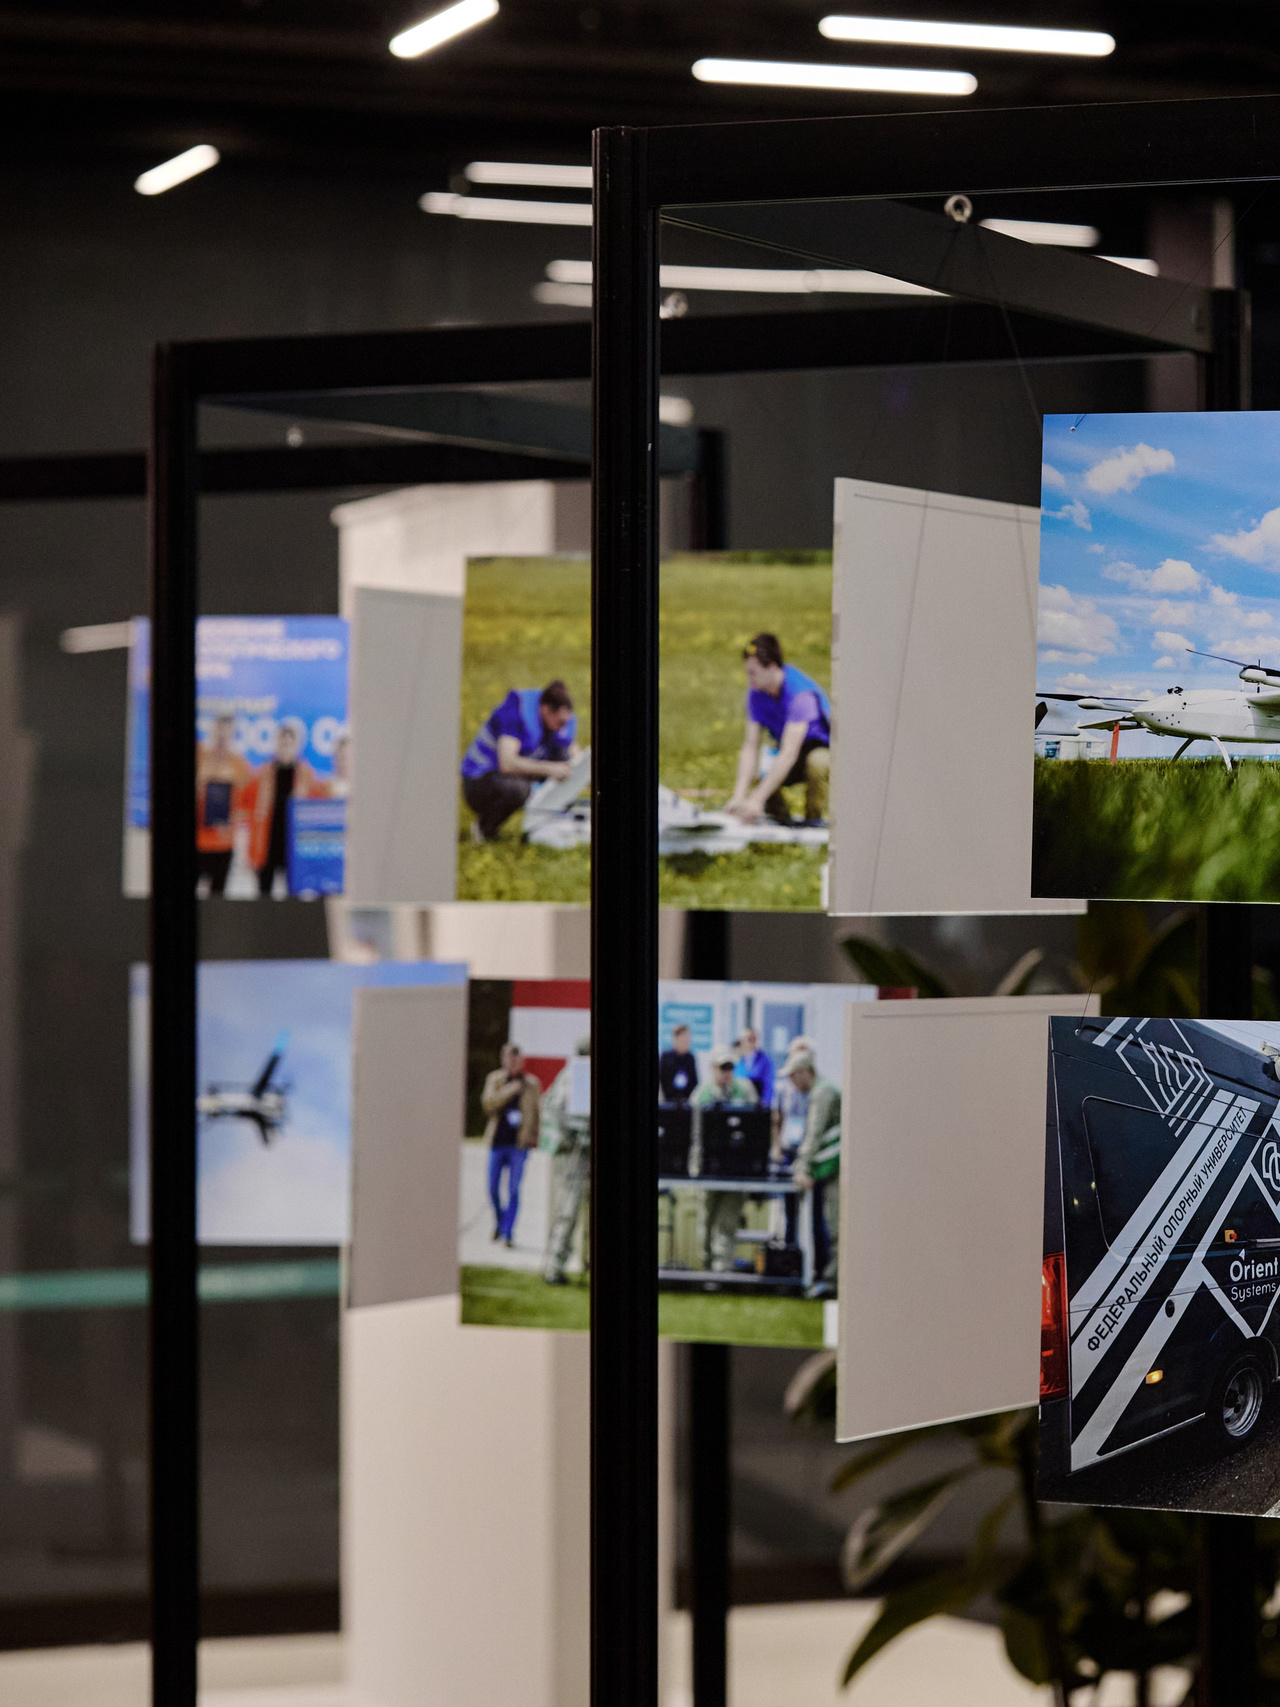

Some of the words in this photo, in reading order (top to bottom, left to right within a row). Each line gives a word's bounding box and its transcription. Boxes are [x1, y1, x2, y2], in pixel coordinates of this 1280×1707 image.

[1087, 1234, 1167, 1351] ФЕДЕРАЛЬНЫЙ
[1163, 1173, 1206, 1238] ОПОРНЫЙ
[1201, 1106, 1247, 1179] УНИВЕРСИТЕТ
[1230, 1256, 1279, 1282] Orient
[1231, 1283, 1277, 1302] Systems
